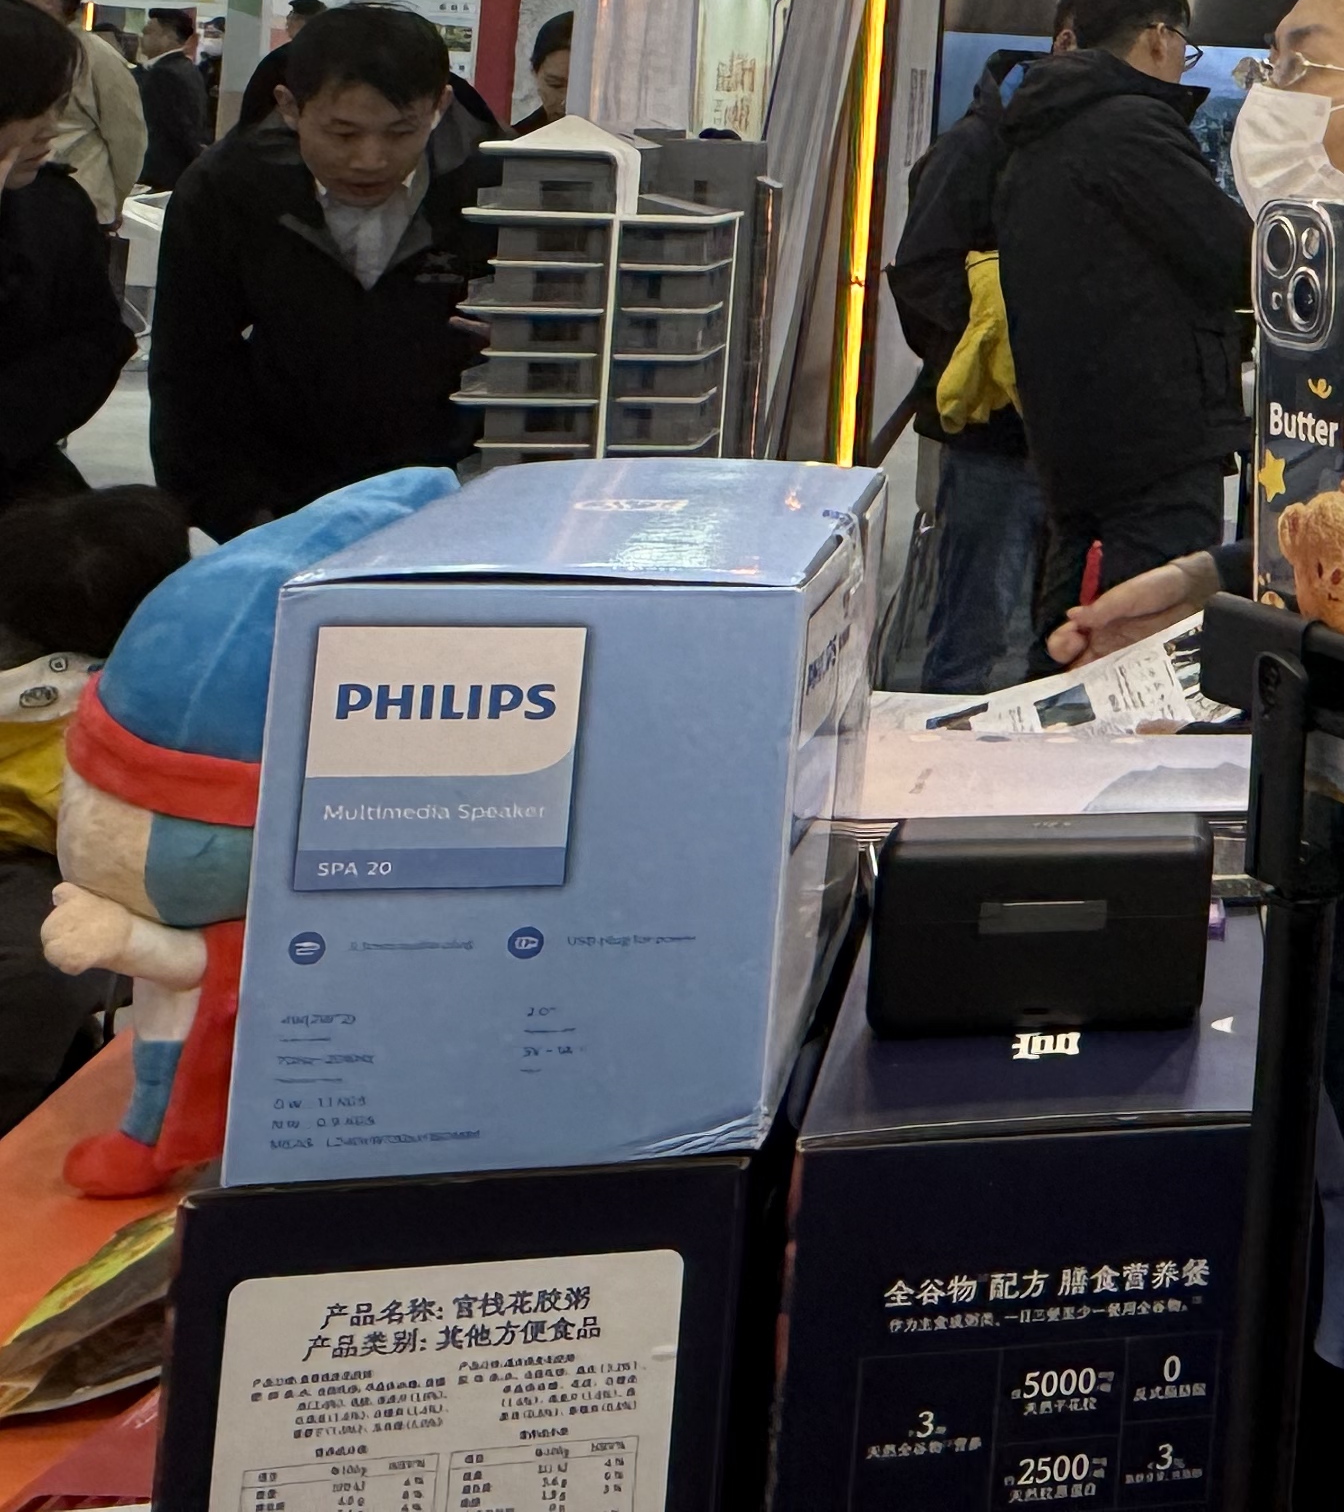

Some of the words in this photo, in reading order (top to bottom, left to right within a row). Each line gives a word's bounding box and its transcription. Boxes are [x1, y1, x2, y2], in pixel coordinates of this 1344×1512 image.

[1269, 401, 1339, 448] Butter
[334, 682, 557, 720] PHILIPS
[323, 803, 451, 822] Multimedia
[457, 803, 546, 822] Speaker
[316, 861, 359, 877] SPA
[366, 861, 392, 876] 20
[884, 1279, 977, 1309] 全谷物
[989, 1269, 1050, 1302] 配方
[1057, 1257, 1211, 1297] 膳食营养餐
[1022, 1367, 1097, 1400] 5000
[1162, 1355, 1182, 1383] 0
[1016, 1453, 1090, 1486] 2500
